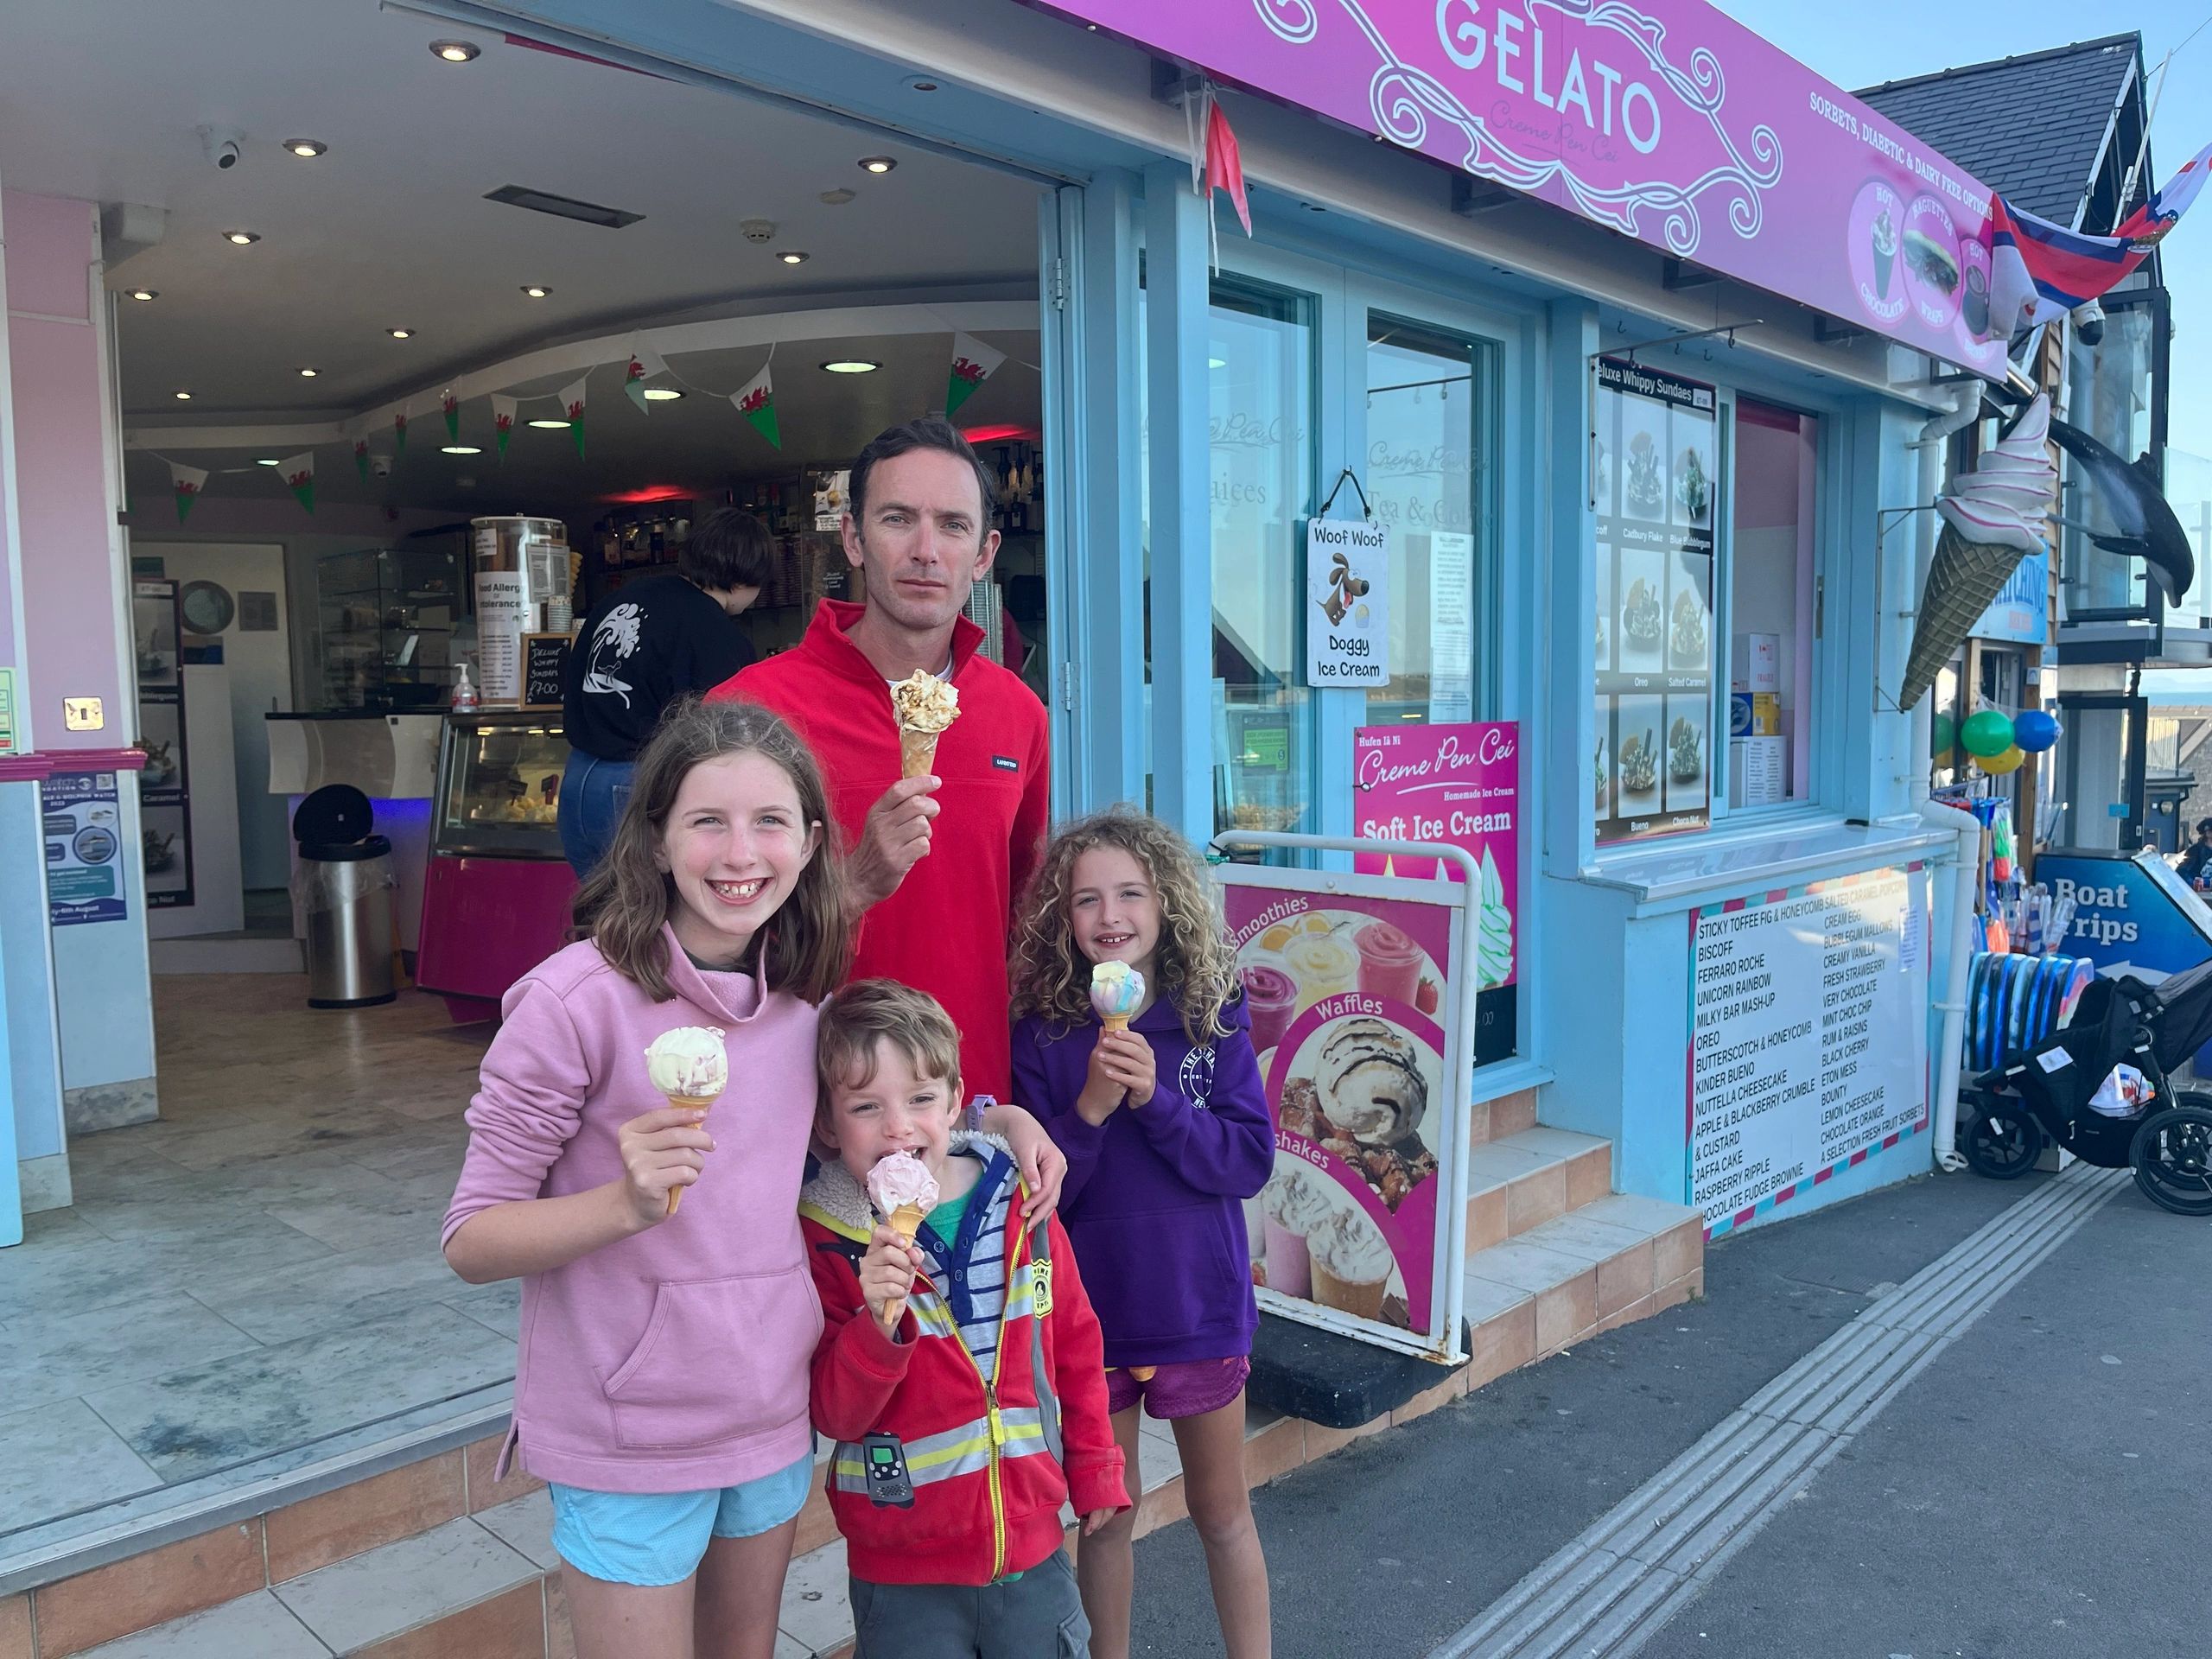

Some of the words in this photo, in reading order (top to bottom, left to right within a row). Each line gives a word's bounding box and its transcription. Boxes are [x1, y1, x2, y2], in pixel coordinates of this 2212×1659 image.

[1436, 0, 1661, 154] GELATO
[1491, 100, 1552, 141] Creme
[1555, 123, 1587, 152] Pen
[1592, 135, 1618, 162] Cei
[1810, 92, 1859, 140] SORBETS,
[1862, 124, 1904, 165] DIABETIC
[1907, 151, 1914, 170] &
[1915, 156, 1940, 188] DAIRY
[1942, 174, 1961, 201] FREE
[1963, 192, 1993, 222] OPTIONS
[1876, 187, 1894, 207] HOT
[1969, 243, 1984, 261] HOT
[1860, 283, 1904, 318] CHOCOLATE
[1921, 301, 1943, 323] WRAPS
[1599, 363, 1621, 382] eluxe
[1623, 369, 1656, 395] Whippy
[1656, 378, 1692, 401] Sundaes
[1210, 472, 1266, 505] uices
[1314, 528, 1348, 547] Woof
[1351, 531, 1384, 549] Woof
[1623, 528, 1647, 543] Cadbury
[1648, 531, 1662, 543] Flake
[1669, 534, 1682, 545] Blue
[1682, 536, 1711, 550] Bubblegum
[1330, 635, 1370, 657] Doggy
[1318, 661, 1336, 677] Ice
[1340, 662, 1380, 678] Cream
[1634, 677, 1648, 687] Oreo
[1669, 677, 1685, 687] Salted
[1686, 677, 1707, 687] Caramel
[1359, 737, 1382, 747] Hufen
[1393, 735, 1401, 746] Ni
[1359, 749, 1431, 789] Creme
[1434, 736, 1476, 772] Pen
[1479, 728, 1514, 766] Cei
[1444, 790, 1481, 801] Homemade
[1482, 788, 1492, 798] Ice
[1494, 787, 1514, 797] Cream
[1363, 816, 1407, 841] Soft
[1414, 815, 1443, 841] Ice
[1450, 810, 1511, 836] Cream
[1630, 822, 1649, 831] Bueno
[1825, 892, 1848, 910] SALTED
[1850, 885, 1878, 904] CARAMEL
[2055, 878, 2128, 908] Boat
[1231, 895, 1309, 950] Smoothies
[1699, 919, 1728, 939] STICKY
[1731, 912, 1758, 932] TOFFEE
[1760, 910, 1771, 925] FIG
[1774, 909, 1779, 922] &
[1781, 898, 1824, 920] HONEYCOMB
[1824, 911, 1847, 930] CREAM
[1848, 909, 1861, 923] EGG
[2065, 913, 2138, 945] rips
[1824, 926, 1863, 950] BUBBLEGUM
[1864, 919, 1892, 938] MALLOWS
[1699, 940, 1733, 962] BISCOFF
[1823, 950, 1850, 969] CREAMY
[1852, 942, 1876, 959] VANILLA
[1698, 961, 1736, 984] FERRARO
[1738, 954, 1764, 974] ROCHE
[1823, 971, 1844, 988] FRESH
[1846, 958, 1885, 982] STRAWBERRY
[1697, 984, 1733, 1007] UNICORN
[1736, 972, 1771, 996] RAINBOW
[1822, 991, 1840, 1008] VERY
[1840, 979, 1878, 1002] CHOCOLATE
[1315, 994, 1383, 1021] Waffles
[1696, 1008, 1721, 1029] MILKY
[1724, 1003, 1739, 1020] BAR
[1742, 992, 1775, 1015] MASH-UP
[1822, 1010, 1838, 1028] MINT
[1839, 1004, 1857, 1022] CHOC
[1858, 999, 1872, 1014] CHIP
[1696, 1031, 1719, 1051] OREO
[1696, 1040, 1758, 1073] BUTTERSCOTCH
[1760, 1037, 1765, 1051] &
[1767, 1020, 1812, 1047] HONEYCOMB
[1822, 1030, 1837, 1047] RUM
[1838, 1028, 1842, 1042] &
[1843, 1020, 1867, 1039] RAISINS
[1184, 1052, 1198, 1069] THE
[1821, 1047, 1843, 1068] BLACK
[1844, 1037, 1869, 1060] CHERRY
[1695, 1071, 1726, 1096] KINDER
[1728, 1061, 1755, 1084] BUENO
[1821, 1069, 1839, 1087] ETON
[1840, 1061, 1857, 1078] MESS
[1695, 1089, 1736, 1117] NUTTELLA
[1738, 1069, 1787, 1101] CHEESECAKE
[1821, 1084, 1847, 1107] BOUNTY
[1821, 1104, 1844, 1126] LEMON
[1845, 1085, 1885, 1115] CHEESECAKE
[1695, 1116, 1721, 1141] APPLE
[1724, 1113, 1729, 1128] &
[1731, 1092, 1781, 1125] BLACKBERRY
[1782, 1077, 1815, 1103] CRUMBLE
[1821, 1116, 1858, 1145] CHOCOLATE
[1859, 1103, 1885, 1126] ORANGE
[1695, 1147, 1700, 1161] &
[1703, 1130, 1740, 1159] CUSTARD
[1821, 1151, 1825, 1165] A
[1827, 1135, 1860, 1161] SELECTION
[1861, 1123, 1881, 1143] FRESH
[1882, 1116, 1898, 1134] FRUIT
[1899, 1103, 1924, 1126] SORBETS
[1694, 1160, 1719, 1184] JAFFA
[1721, 1149, 1743, 1171] CAKE
[1694, 1171, 1743, 1206] RASPBERRY
[1744, 1157, 1770, 1183] RIPPLE
[1703, 1192, 1742, 1224] HOCOLATE
[1744, 1180, 1770, 1204] FUDGE
[1771, 1161, 1803, 1190] BROWNIE
